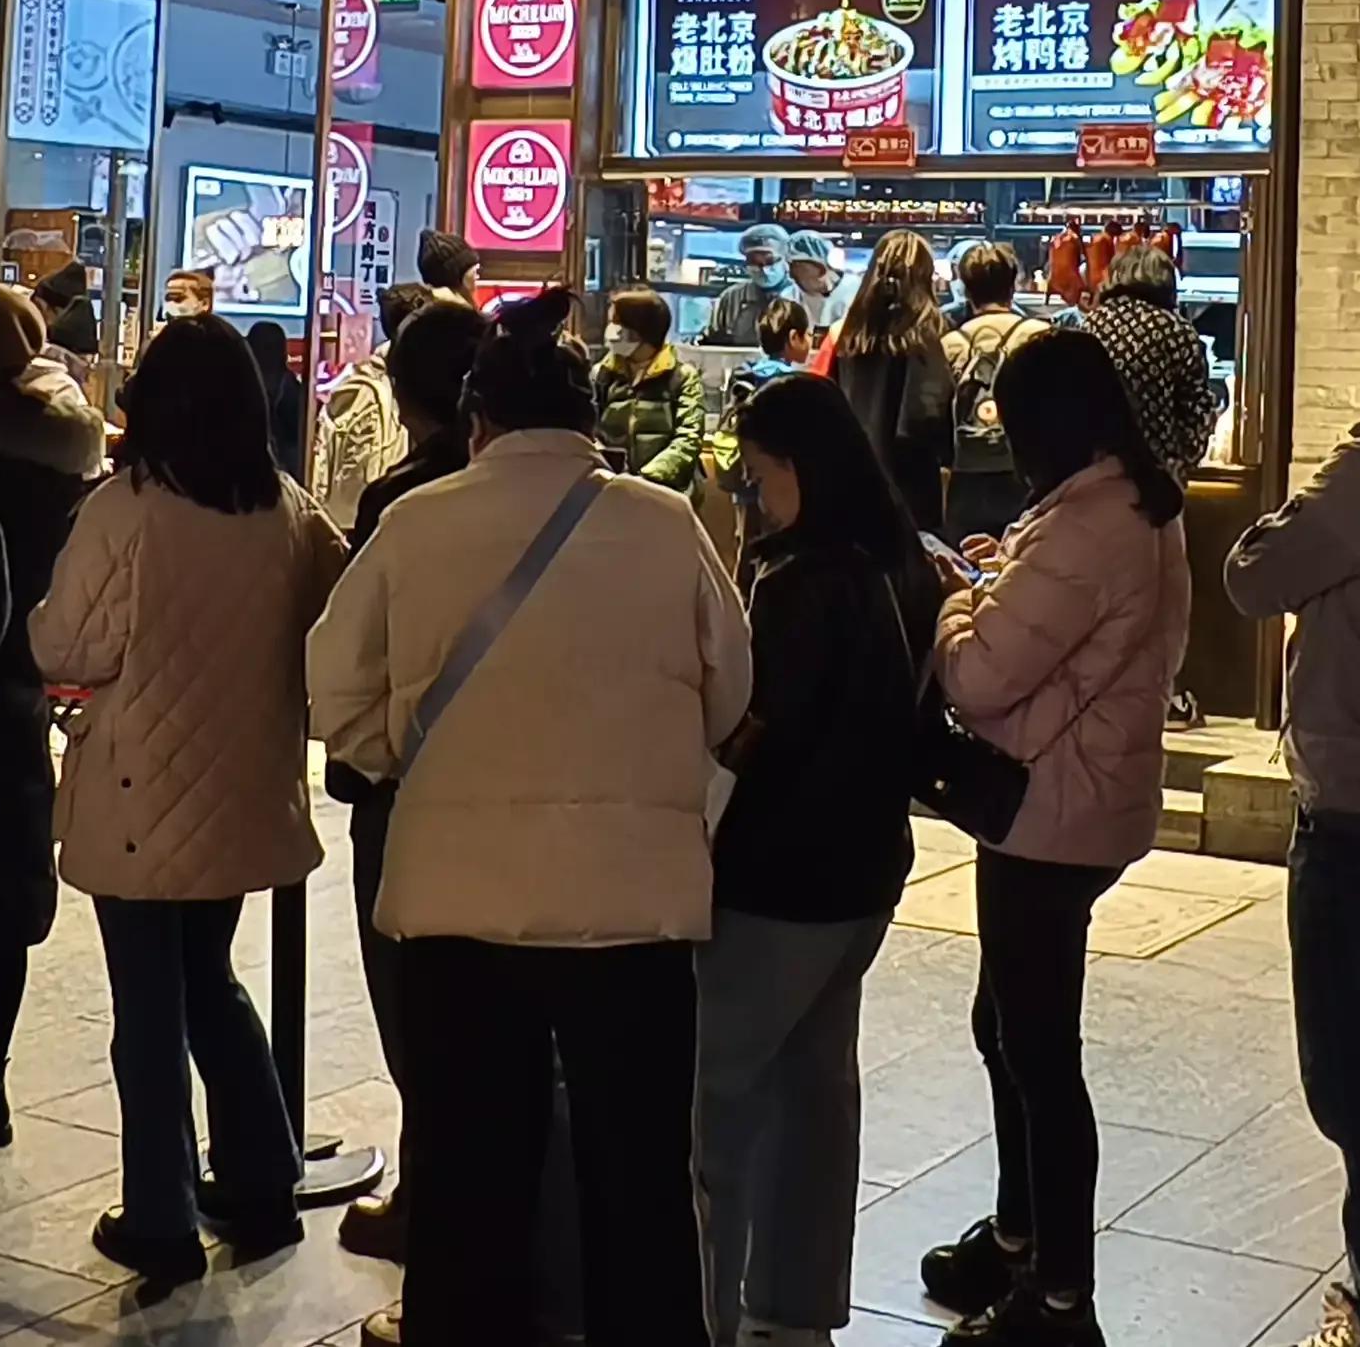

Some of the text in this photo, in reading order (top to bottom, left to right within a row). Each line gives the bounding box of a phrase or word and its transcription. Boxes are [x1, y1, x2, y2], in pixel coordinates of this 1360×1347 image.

[671, 10, 757, 44] 老北京
[992, 1, 1091, 37] 老北京
[991, 36, 1091, 71] 烤鸭卷
